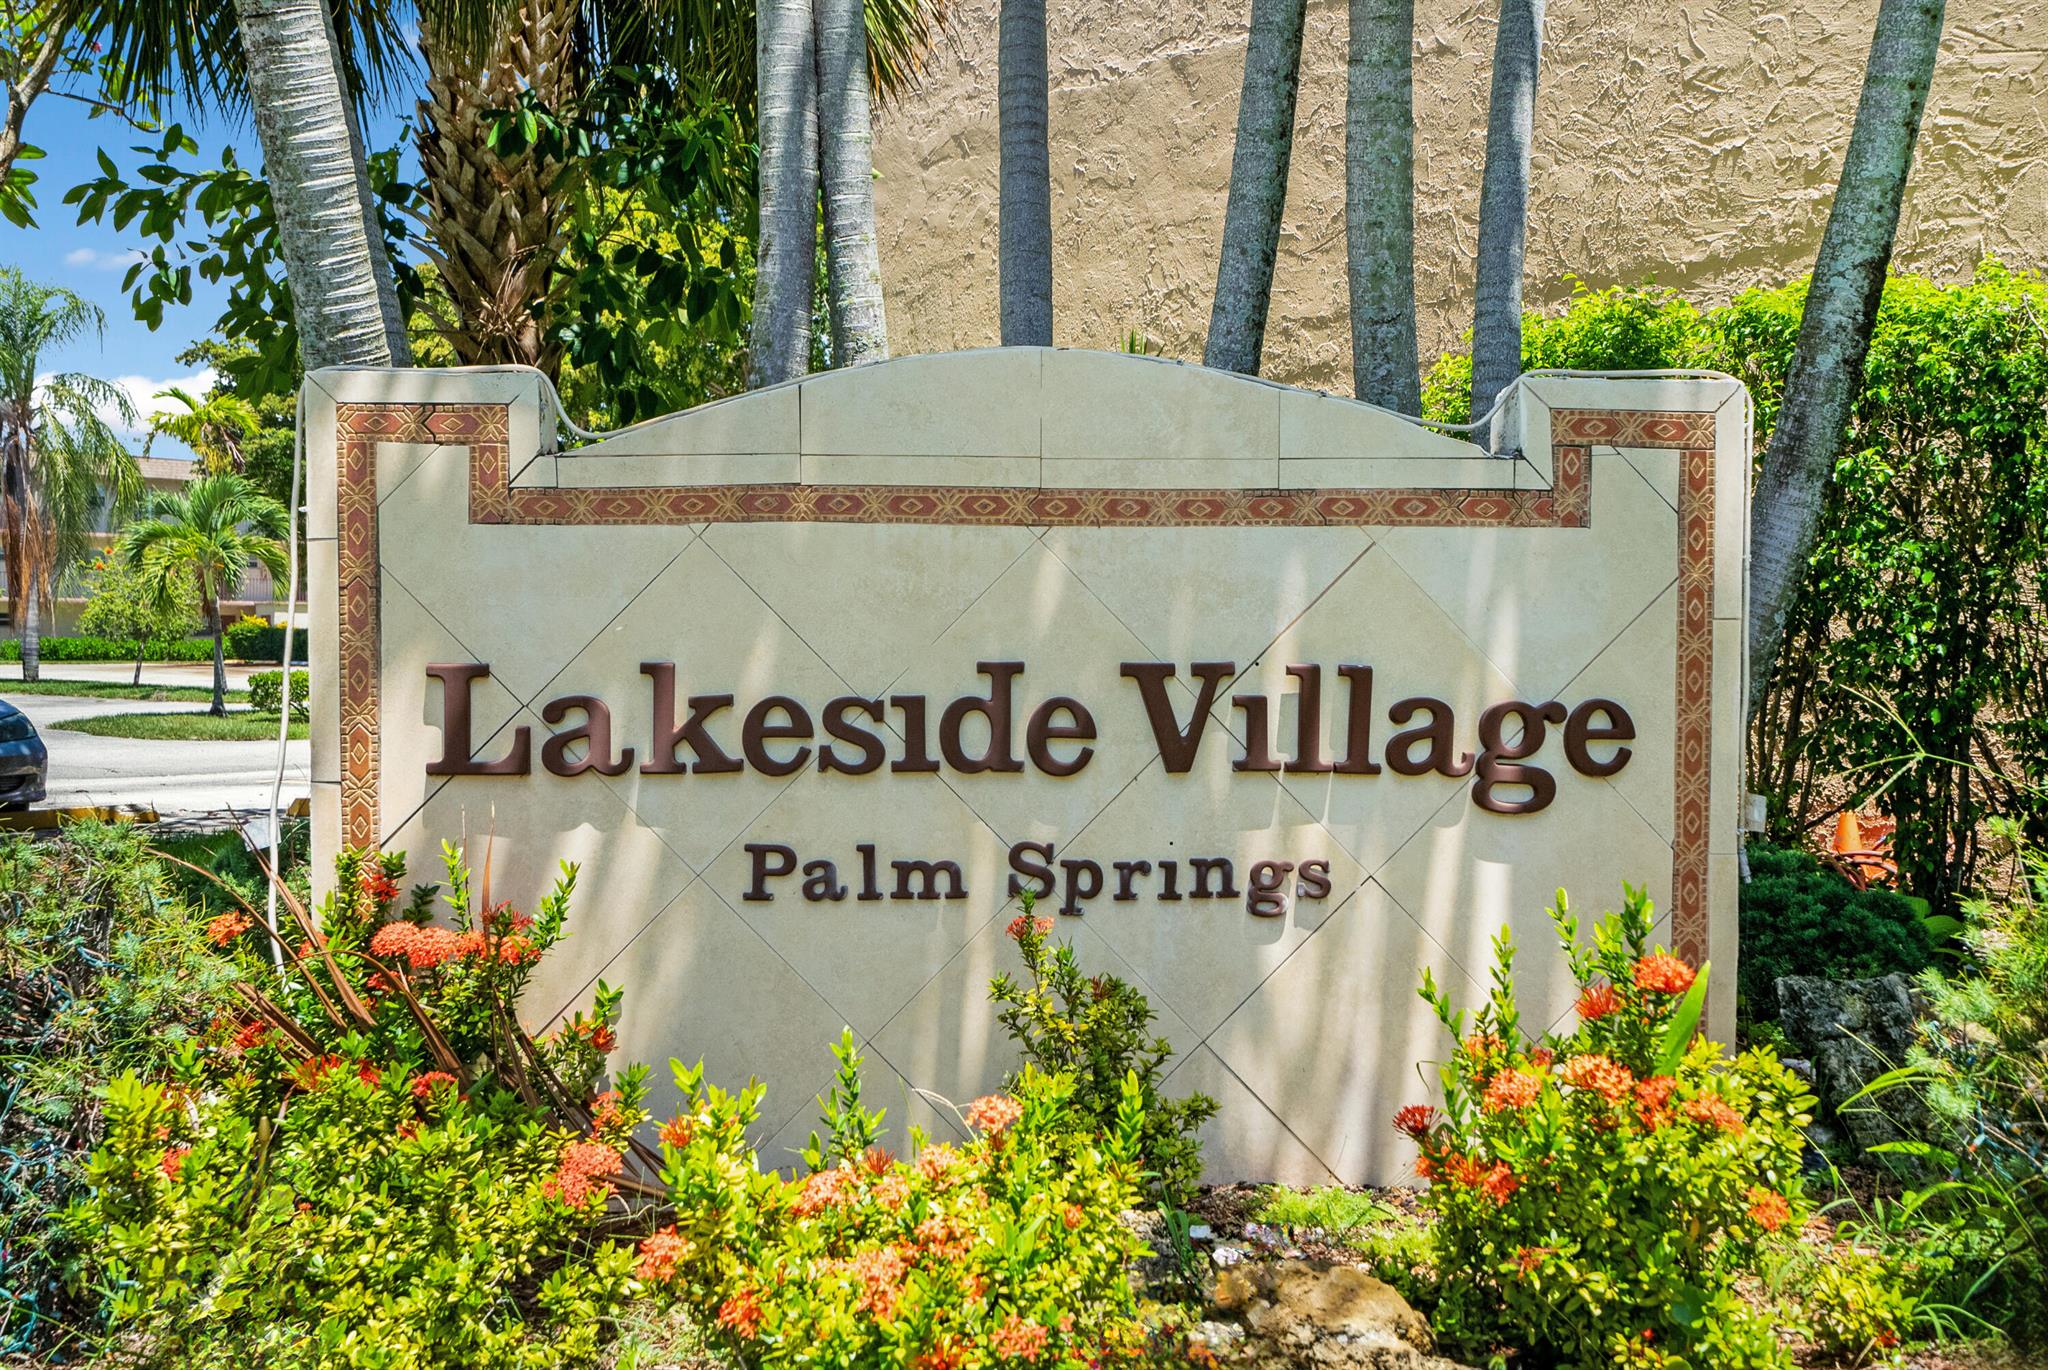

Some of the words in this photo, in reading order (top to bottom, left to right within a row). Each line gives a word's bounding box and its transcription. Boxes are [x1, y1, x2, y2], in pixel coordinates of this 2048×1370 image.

[425, 661, 1098, 777] Lakeside
[1119, 661, 1637, 814] Village
[743, 843, 969, 901] Palm
[1007, 840, 1333, 918] Springs
